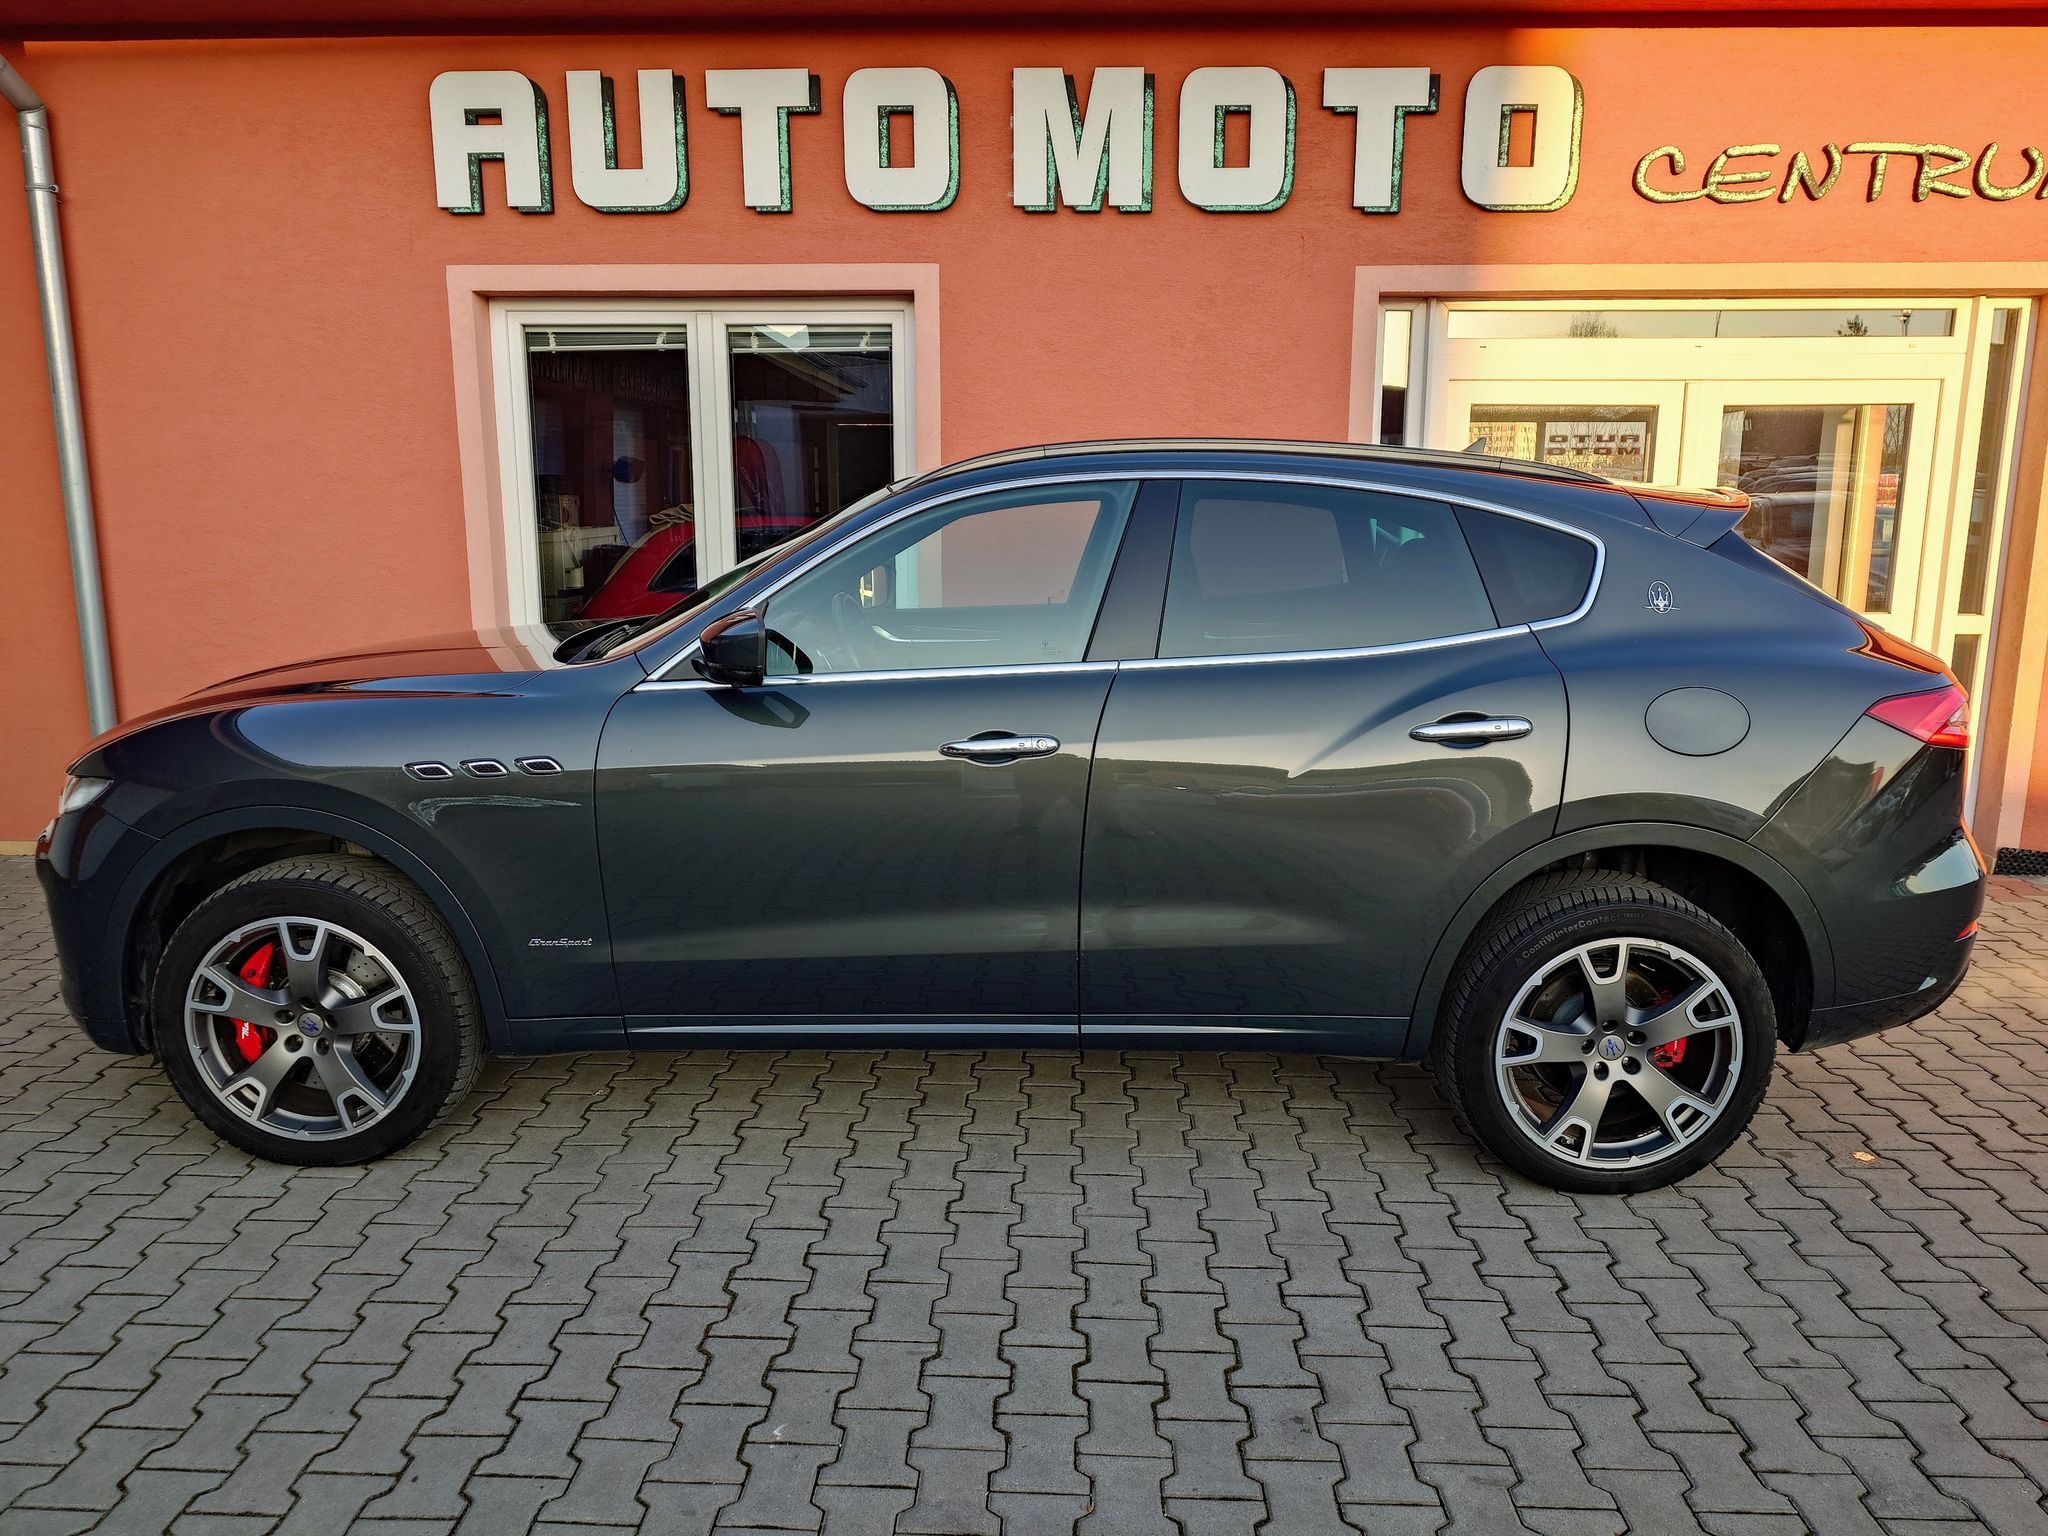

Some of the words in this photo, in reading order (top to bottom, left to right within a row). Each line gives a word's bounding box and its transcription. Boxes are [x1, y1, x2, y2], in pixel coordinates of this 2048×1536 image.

[429, 67, 960, 214] AUTO
[1012, 65, 1584, 214] MOTO
[1635, 141, 2048, 204] CENTRU
[527, 937, 593, 948] GranSport
